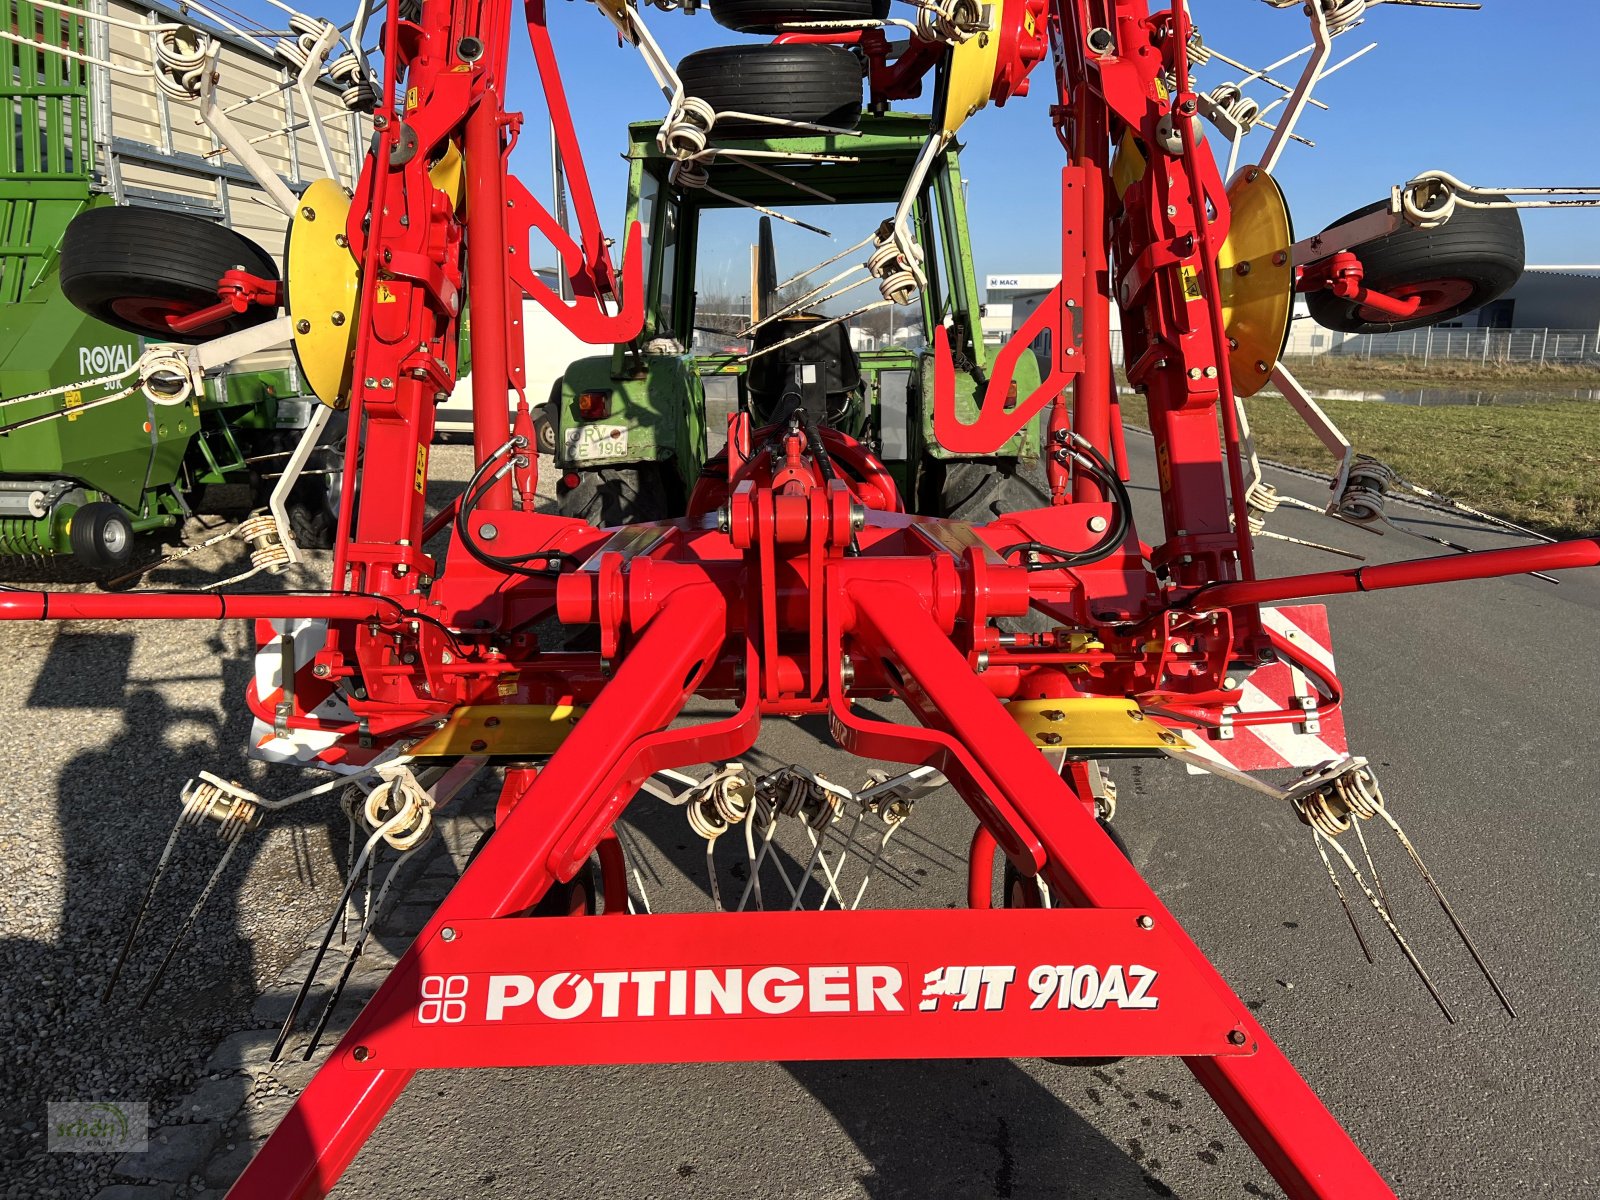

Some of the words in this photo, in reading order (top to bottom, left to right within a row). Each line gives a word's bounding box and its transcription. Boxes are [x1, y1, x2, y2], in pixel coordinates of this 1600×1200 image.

[79, 344, 134, 376] ROYAL
[598, 441, 624, 455] 196
[485, 965, 905, 1021] PÖTTINGER
[1027, 964, 1159, 1011] 910AZ
